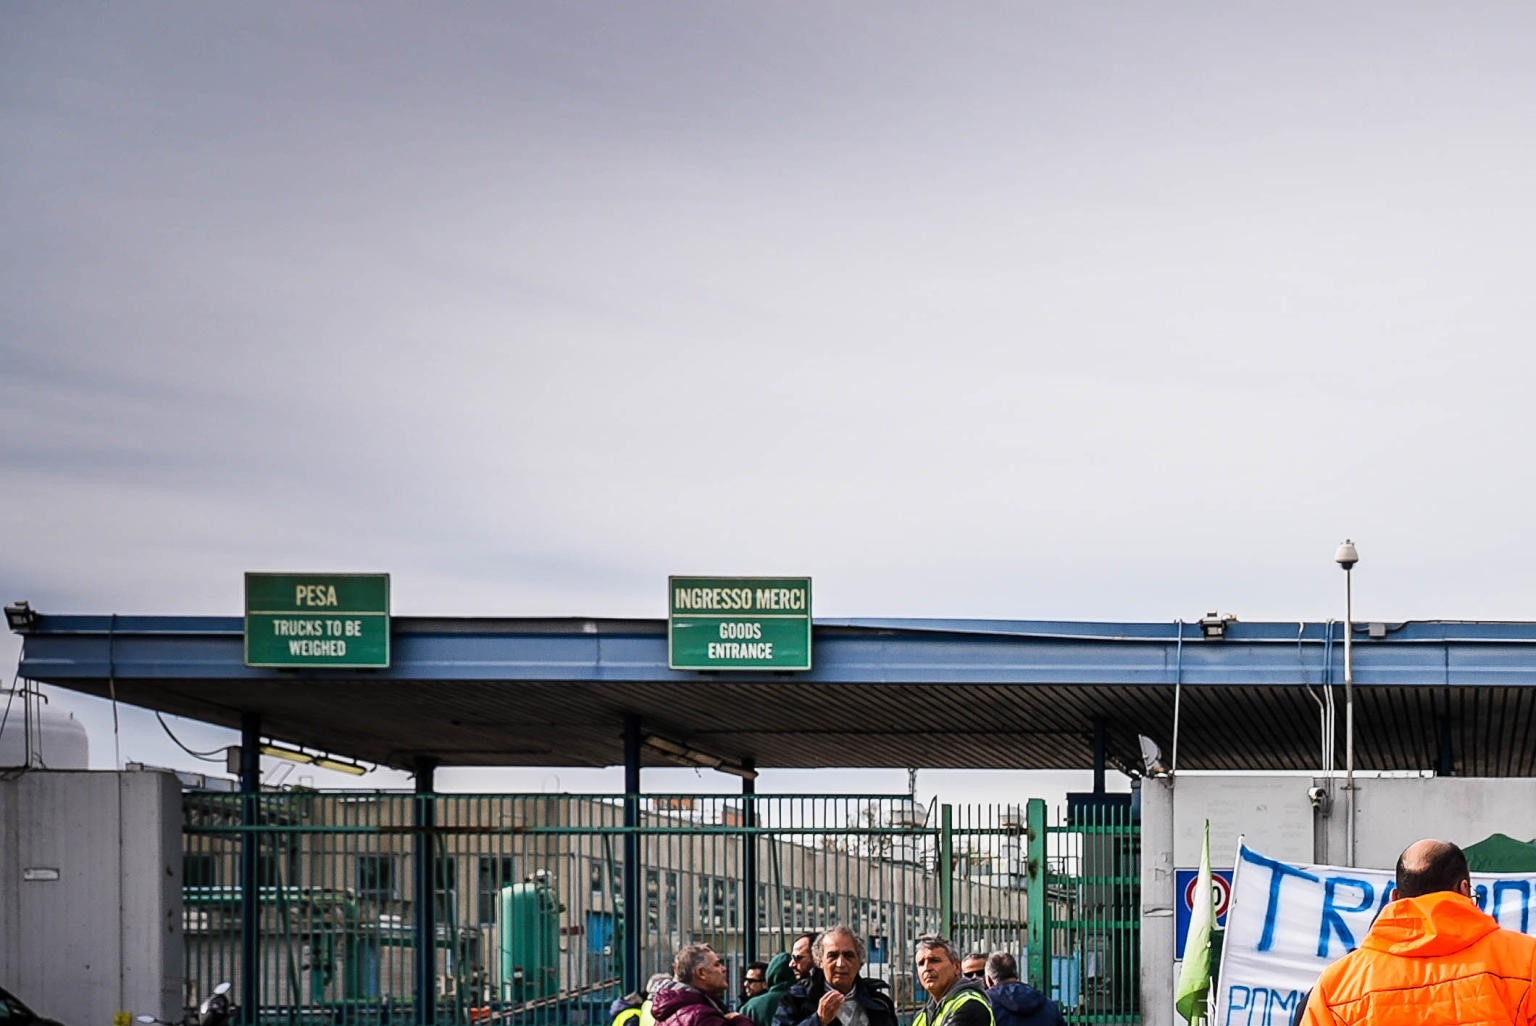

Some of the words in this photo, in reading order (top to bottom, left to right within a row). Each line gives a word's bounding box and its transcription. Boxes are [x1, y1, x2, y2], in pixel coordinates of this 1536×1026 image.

[295, 585, 338, 606] PESA
[675, 588, 752, 609] INGRESSO
[756, 588, 806, 610] MERCI
[273, 619, 323, 636] TRUCKS
[325, 620, 342, 636] TO
[345, 620, 362, 637] BE
[719, 622, 762, 640] GOODS
[288, 640, 346, 657] WEIGHED
[708, 643, 773, 659] ENTRANCE
